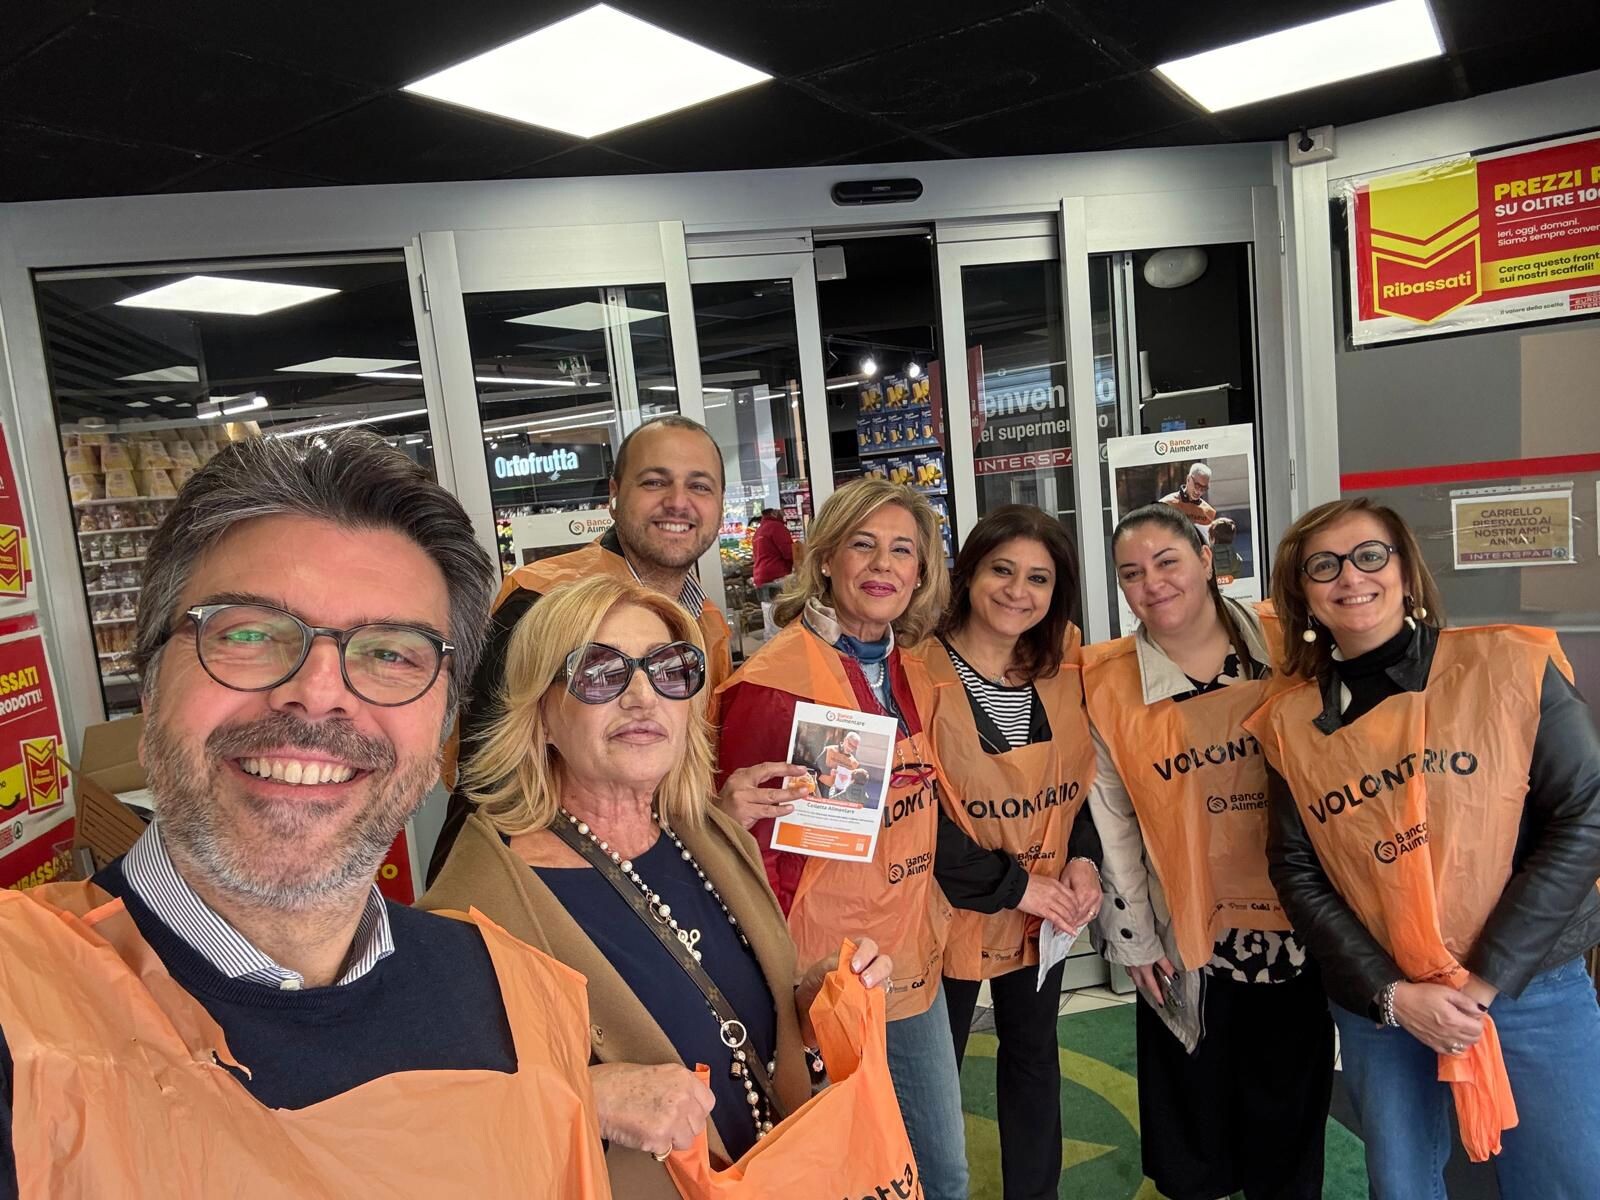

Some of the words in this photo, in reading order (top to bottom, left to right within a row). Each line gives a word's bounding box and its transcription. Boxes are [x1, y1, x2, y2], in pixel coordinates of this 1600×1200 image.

[1494, 169, 1582, 201] PREZZI
[1495, 202, 1518, 217] SU
[1522, 192, 1575, 213] OLTRE
[1515, 225, 1538, 236] oggi,
[1540, 217, 1580, 231] domani.
[1498, 236, 1528, 247] Siamo
[1529, 230, 1566, 242] sempre
[1499, 263, 1531, 274] Cerca
[1533, 257, 1571, 270] questo
[1499, 273, 1515, 283] sui
[1517, 269, 1548, 281] nostri
[1550, 262, 1594, 276] scaffali!
[1383, 271, 1472, 298] Ribassati
[1169, 439, 1191, 447] Banco
[1169, 443, 1209, 454] Alimentare
[494, 448, 580, 479] Ortofrutta
[1480, 506, 1543, 519] CARRELLO
[1539, 515, 1552, 525] AI
[586, 519, 612, 527] Banco
[1474, 527, 1516, 538] NOSTRI
[1519, 525, 1551, 536] AMICI
[1469, 549, 1552, 561] INTERSPAR
[1153, 735, 1260, 781] VOLONT
[1230, 792, 1265, 802] Banco
